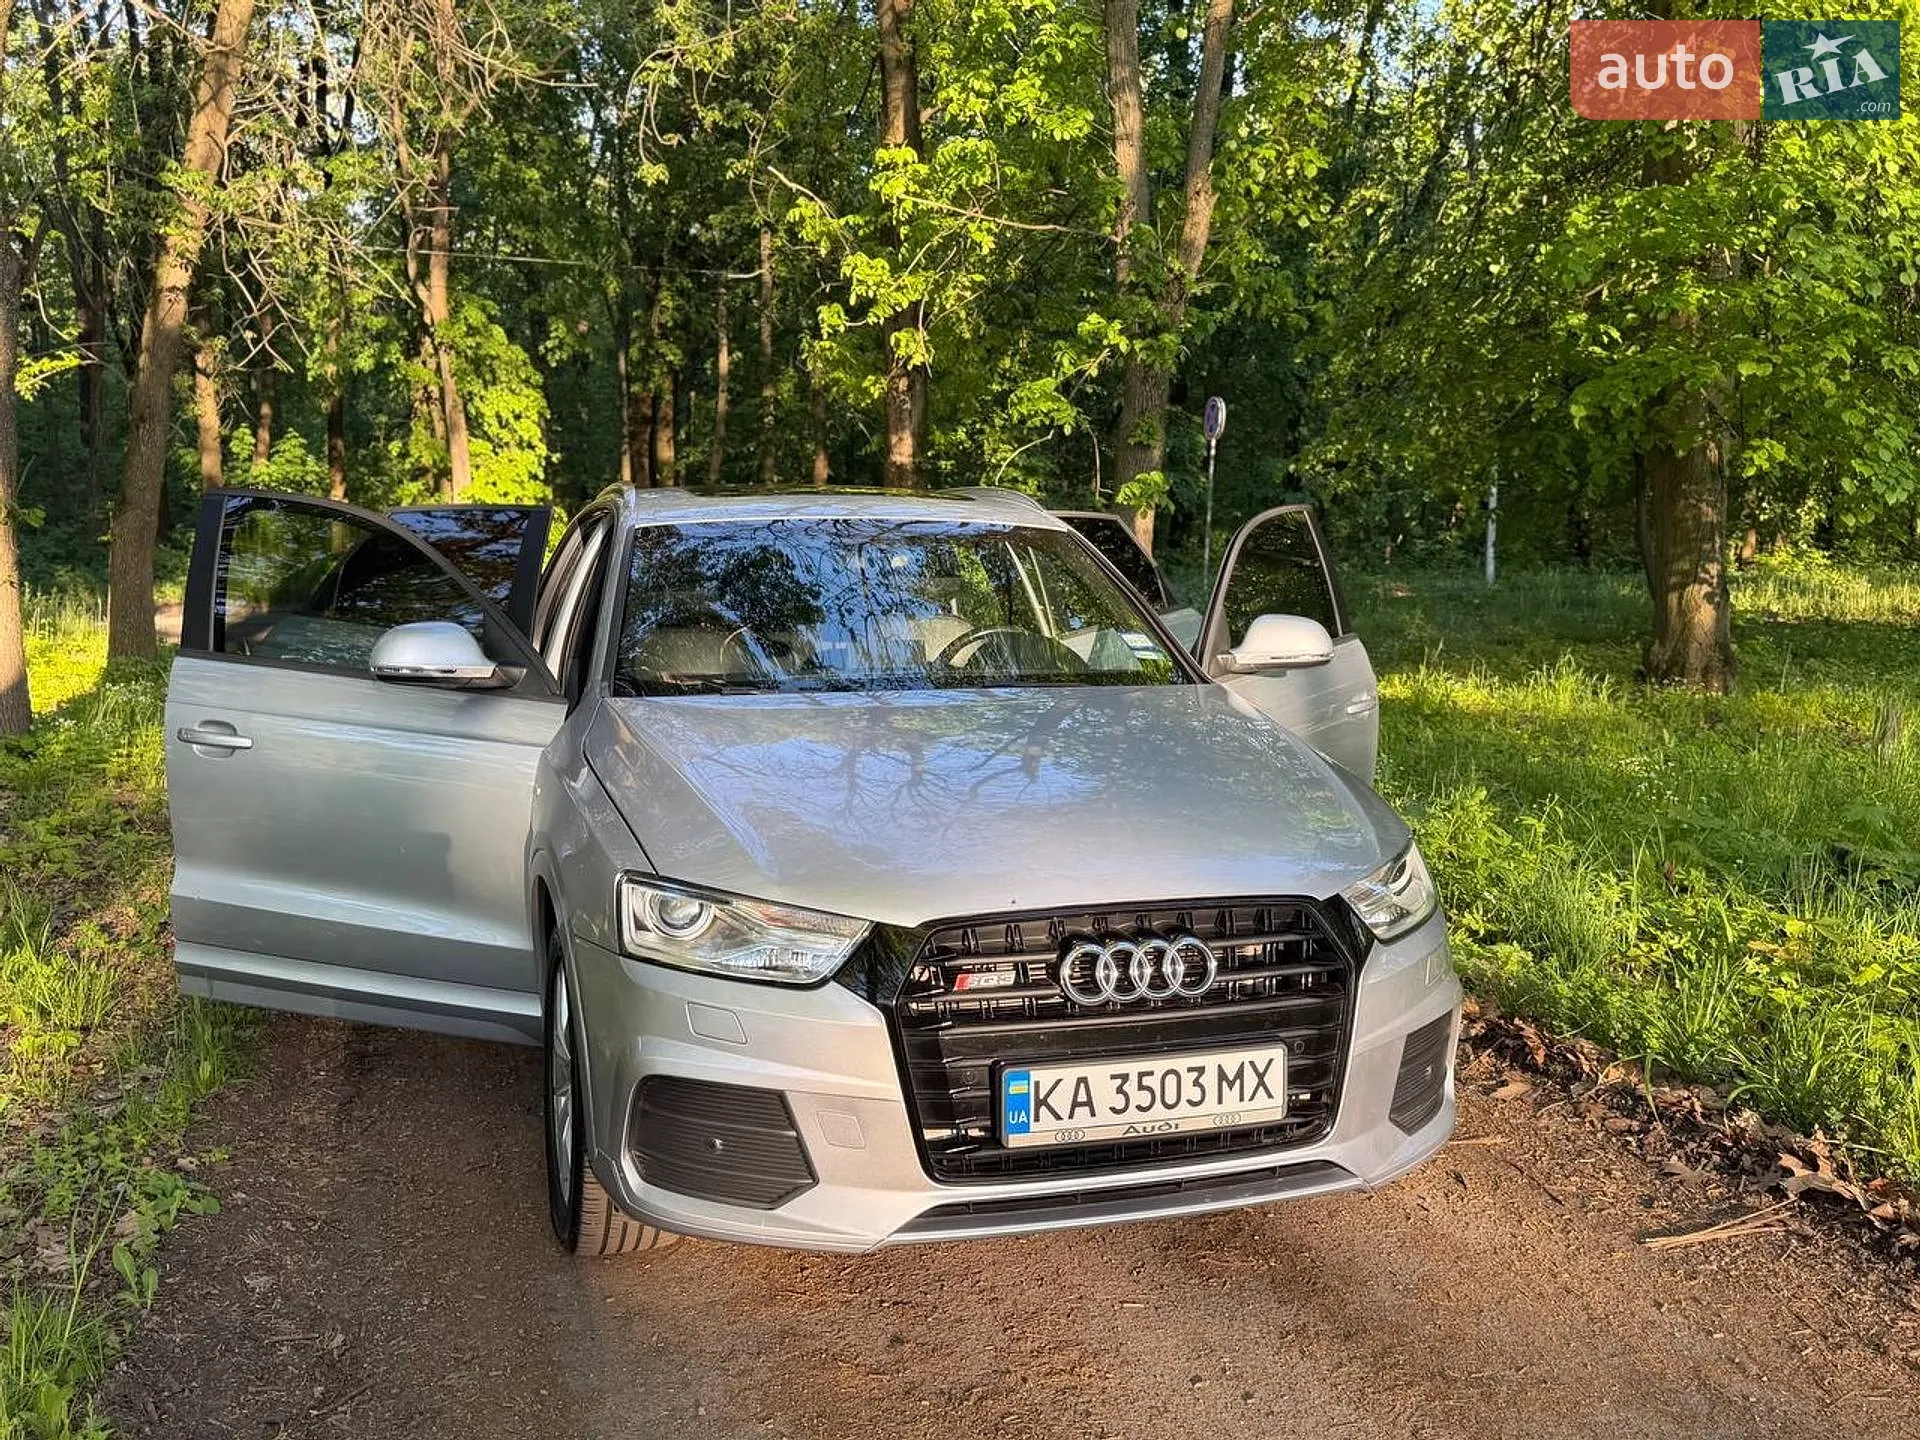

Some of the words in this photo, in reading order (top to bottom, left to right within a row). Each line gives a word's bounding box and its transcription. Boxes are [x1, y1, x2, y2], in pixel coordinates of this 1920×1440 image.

[1032, 1076, 1096, 1123] KA
[1108, 1065, 1206, 1115] 3503
[1216, 1058, 1275, 1106] MX
[1008, 1111, 1029, 1126] UA
[1122, 1123, 1180, 1137] Audi
